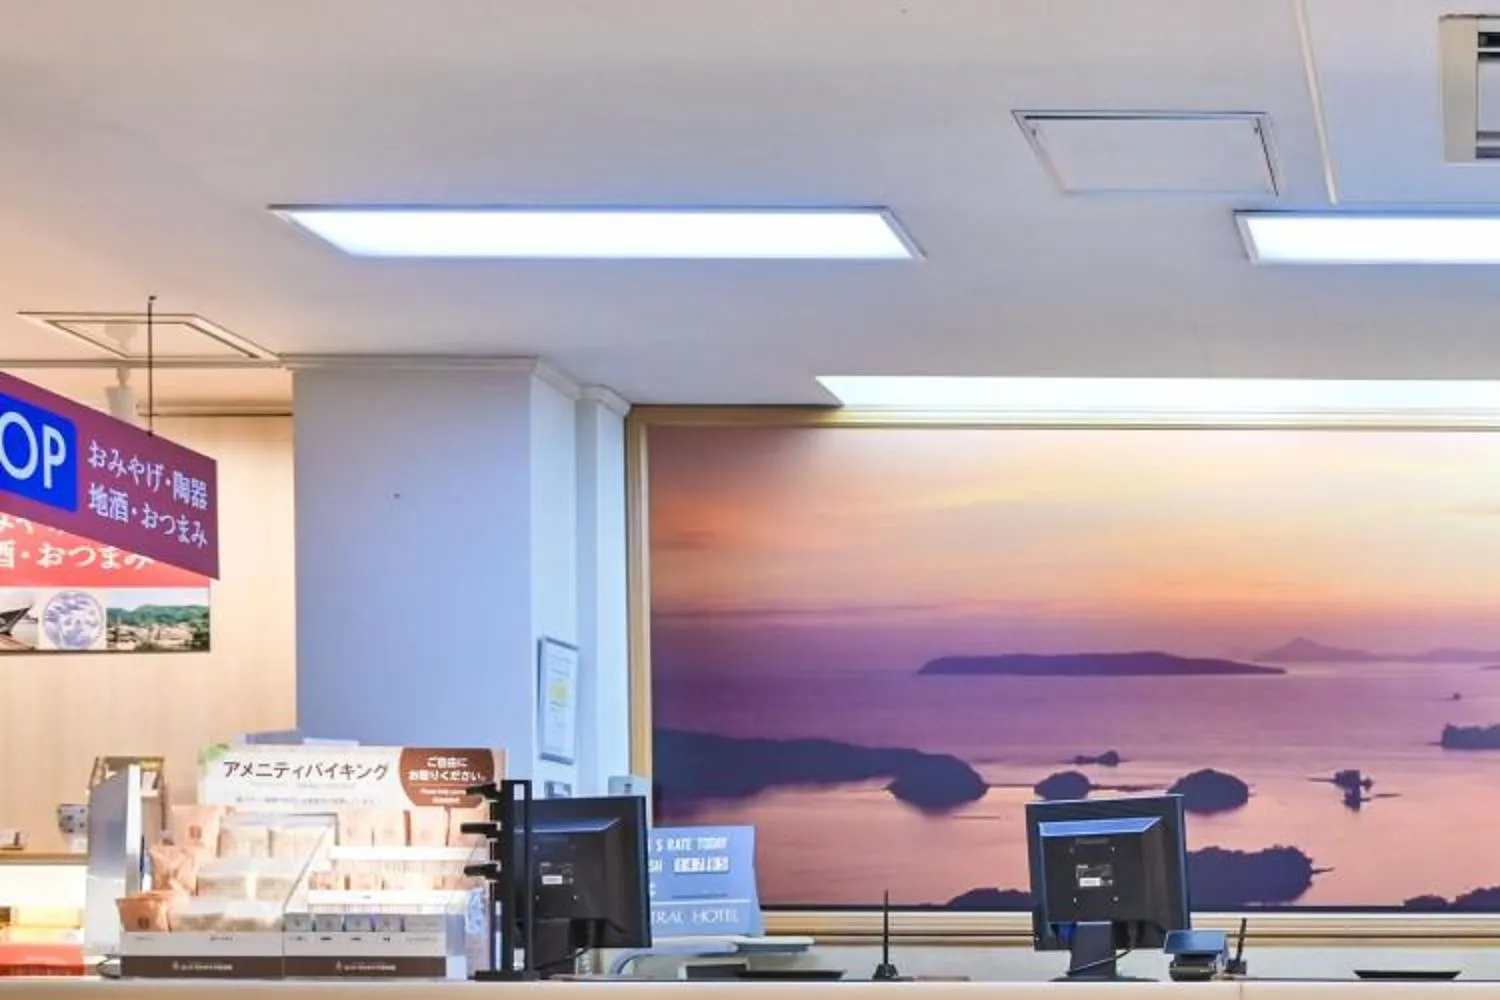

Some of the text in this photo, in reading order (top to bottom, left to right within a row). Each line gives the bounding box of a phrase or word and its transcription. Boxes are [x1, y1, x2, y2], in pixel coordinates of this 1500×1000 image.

[88, 440, 208, 510] おみやげ・陶器
[88, 483, 208, 548] 地酒・おつまみ
[223, 760, 389, 780] アメニティバイキング
[692, 909, 739, 923] HOTEL
